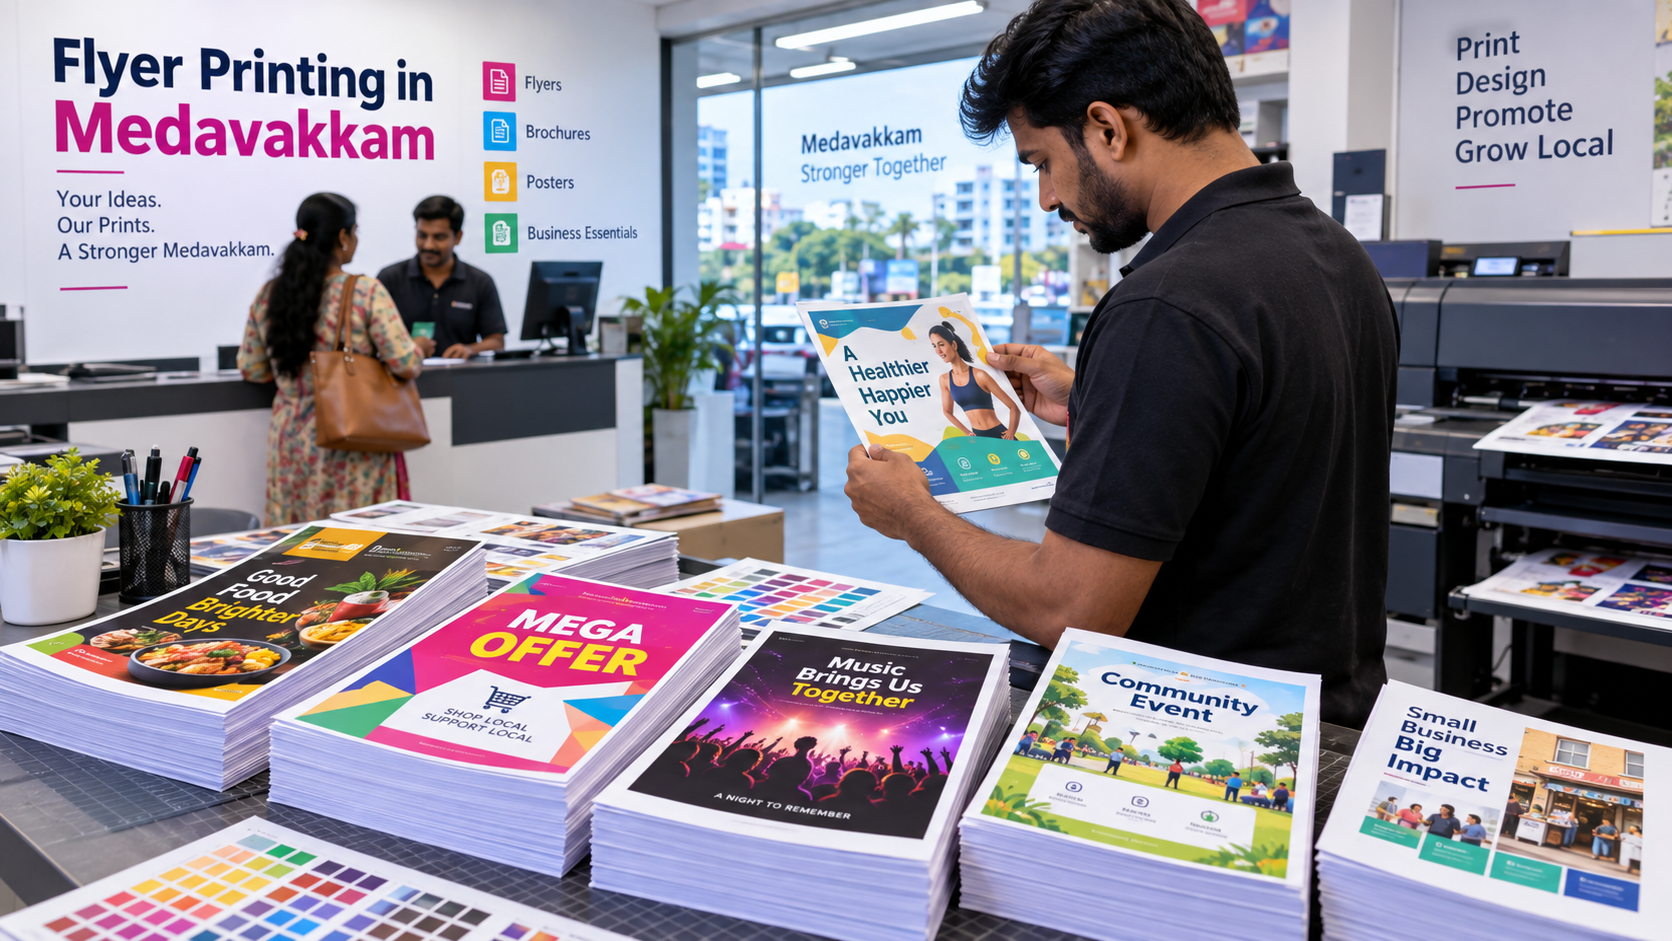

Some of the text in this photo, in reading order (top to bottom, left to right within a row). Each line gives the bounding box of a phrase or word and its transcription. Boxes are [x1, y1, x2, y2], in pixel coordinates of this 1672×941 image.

[1457, 31, 1520, 61] Print
[53, 37, 433, 111] Flyer Printing in
[525, 76, 562, 95] Flyers
[1456, 65, 1546, 96] Design
[1456, 99, 1573, 130] Promote
[55, 100, 435, 161] Medavakkam
[526, 125, 591, 141] Brochures
[801, 125, 922, 154] Medavakkam
[1455, 129, 1613, 163] Grow Local
[526, 175, 574, 190] Posters
[801, 154, 947, 184] Stronger Together
[56, 190, 162, 208] Your Ideas.
[57, 216, 155, 234] Our Prints.
[527, 225, 638, 241] Business Essentials
[58, 241, 275, 264] A Stronger Medavakkam.
[843, 345, 858, 362] A
[849, 358, 930, 382] Healthier
[858, 381, 931, 406] Happier
[869, 409, 908, 426] You
[247, 569, 317, 589] Good
[216, 584, 301, 605] Food
[153, 611, 227, 634] Days
[185, 597, 301, 625] Brighter
[507, 609, 643, 645] MEGA
[470, 631, 648, 676] OFFER
[827, 656, 906, 676] Music
[796, 667, 923, 694] Brings Us
[1101, 671, 1259, 717] Community
[791, 682, 915, 709] Together
[1130, 693, 1213, 723] Event
[422, 712, 533, 744] SUPPORT LOCAL
[443, 707, 529, 732] SHOP LOCAL
[1406, 706, 1477, 733] Small
[1395, 735, 1443, 763] Big
[1400, 720, 1509, 756] Business
[1387, 754, 1490, 792] Impact
[726, 793, 763, 807] NIGHT
[767, 801, 782, 809] TO
[784, 804, 852, 820] REMEMBER
